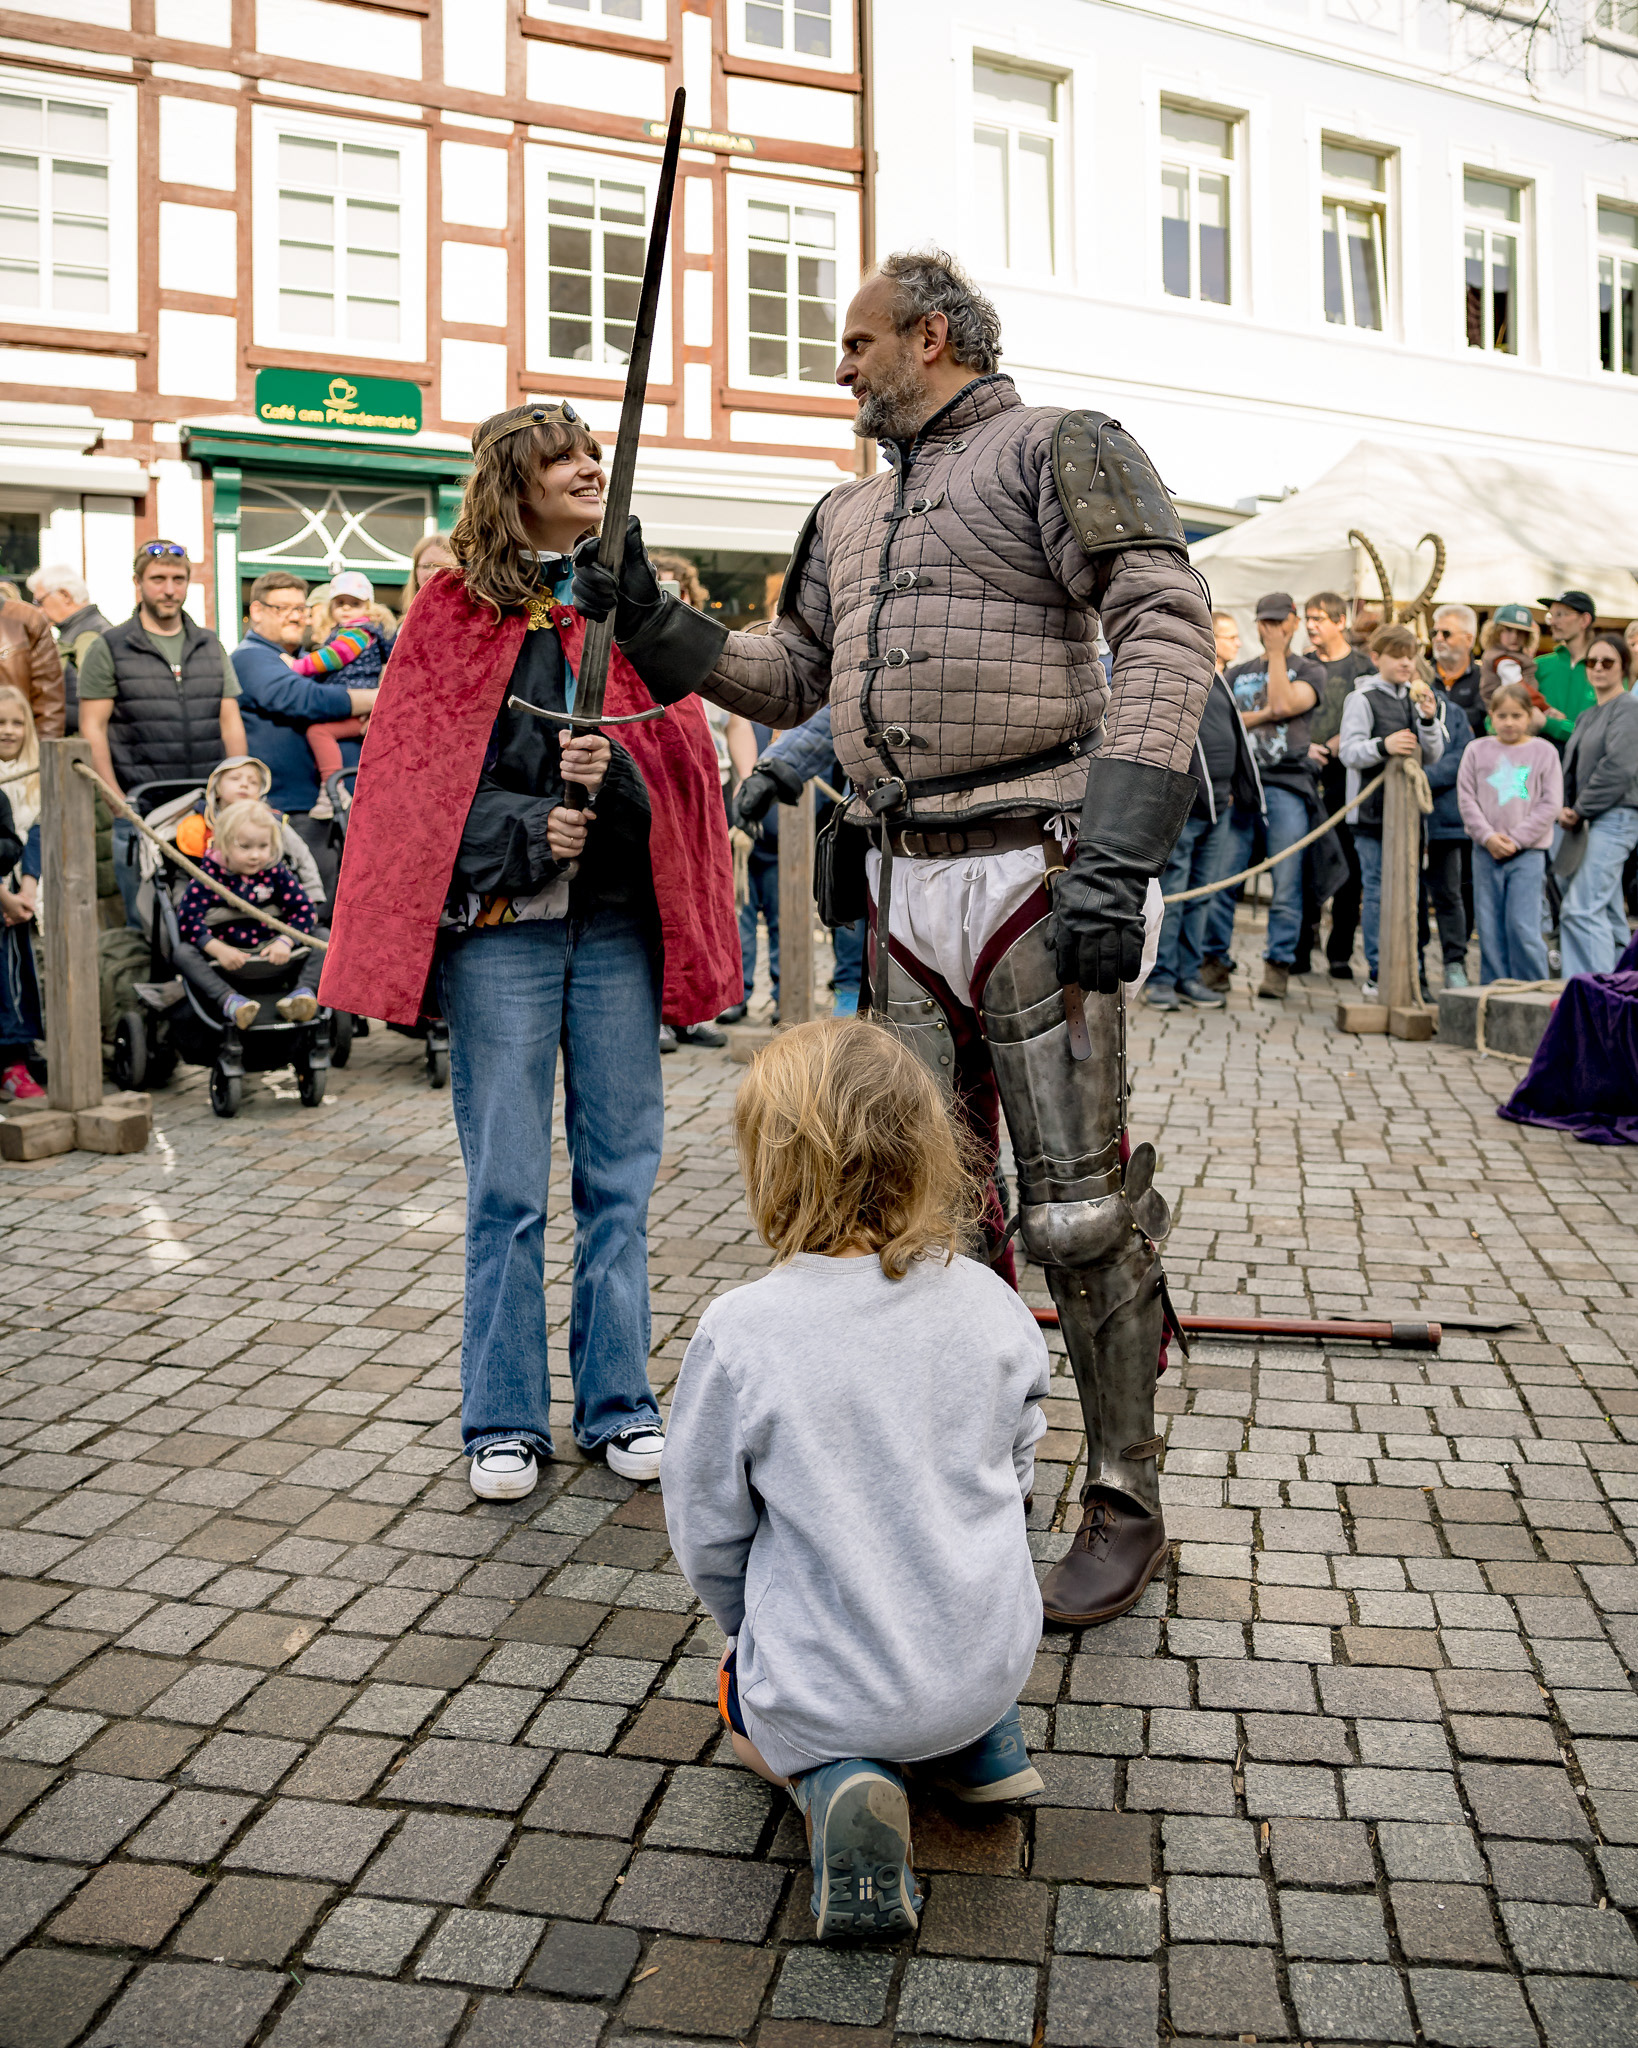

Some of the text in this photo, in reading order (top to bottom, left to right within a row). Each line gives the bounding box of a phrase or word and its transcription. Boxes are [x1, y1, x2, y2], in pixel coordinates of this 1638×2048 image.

[260, 403, 417, 431] Café am Pferdemarkt
